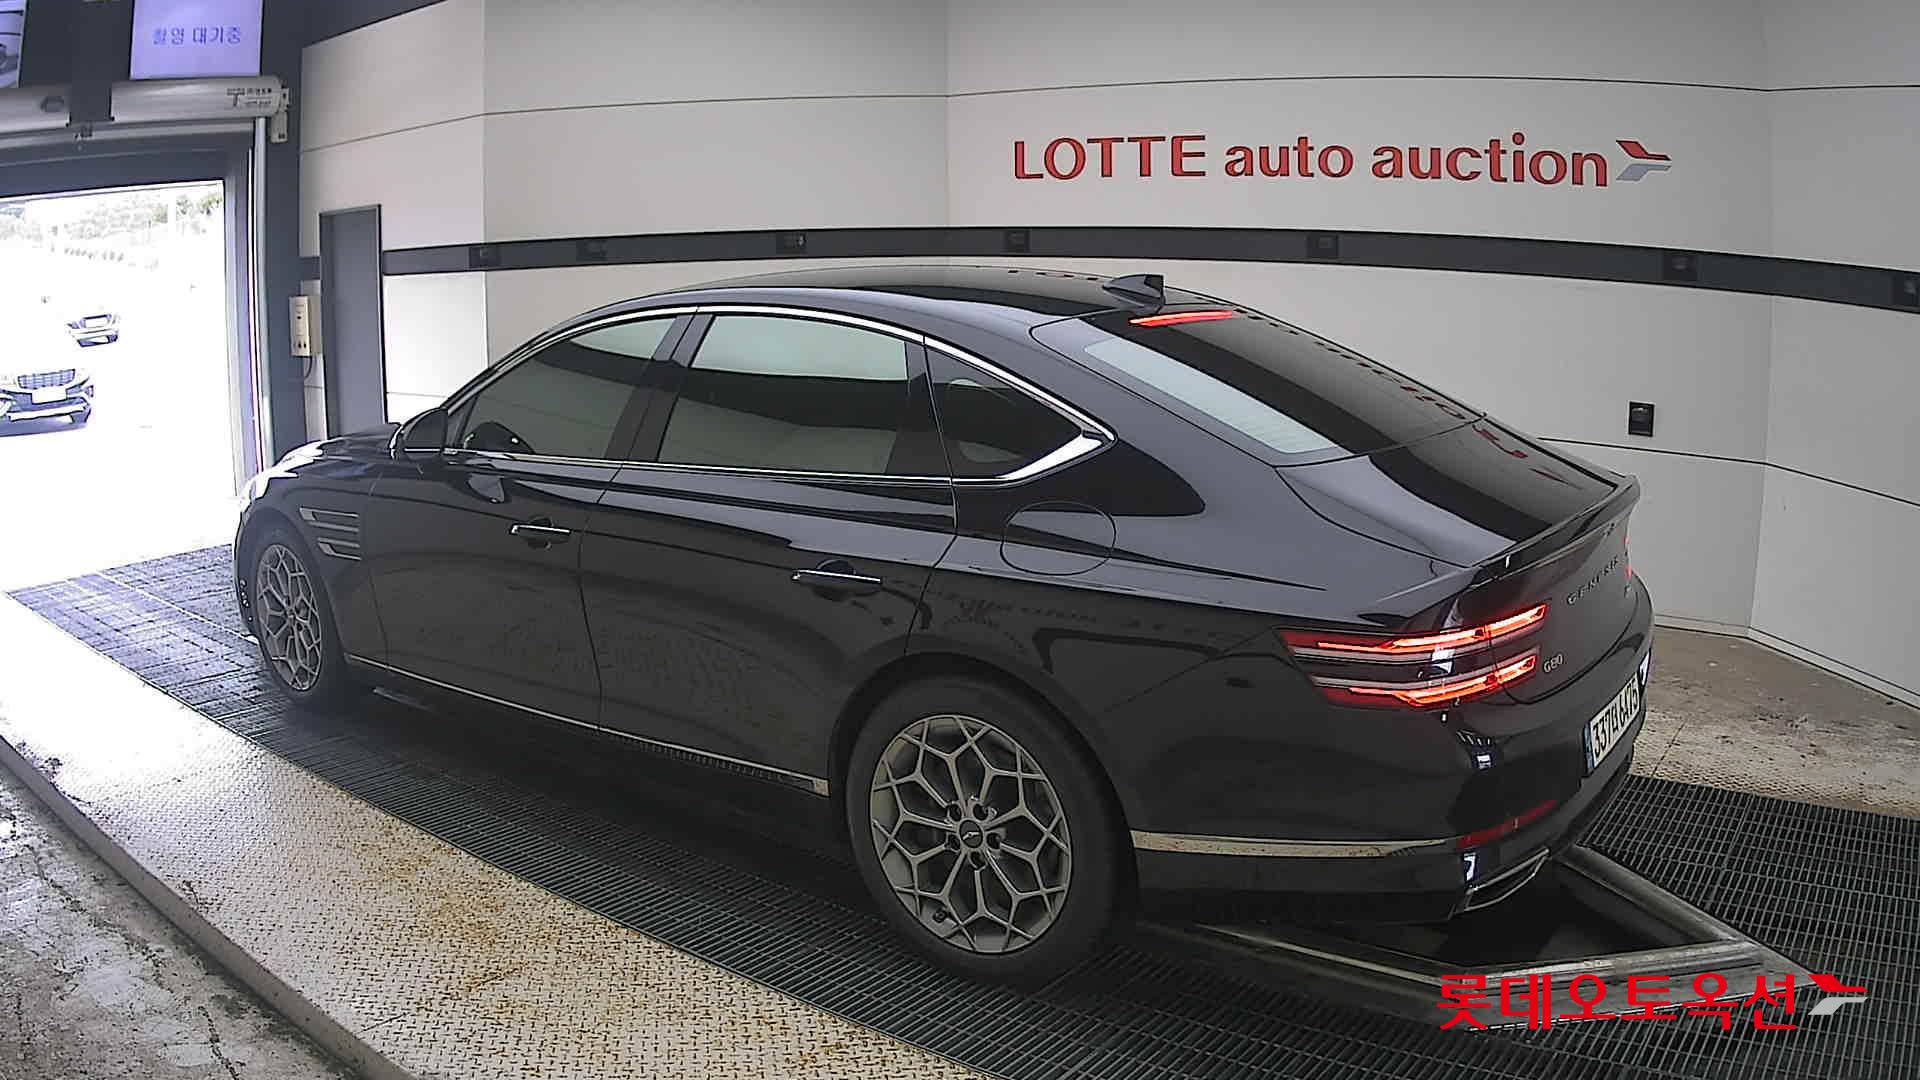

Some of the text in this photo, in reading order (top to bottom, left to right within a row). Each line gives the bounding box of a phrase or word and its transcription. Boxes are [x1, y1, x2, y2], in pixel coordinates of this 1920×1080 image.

[192, 26, 241, 45] 대기중
[1014, 132, 1609, 187] LOTTE auto auction
[1543, 653, 1564, 674] G80
